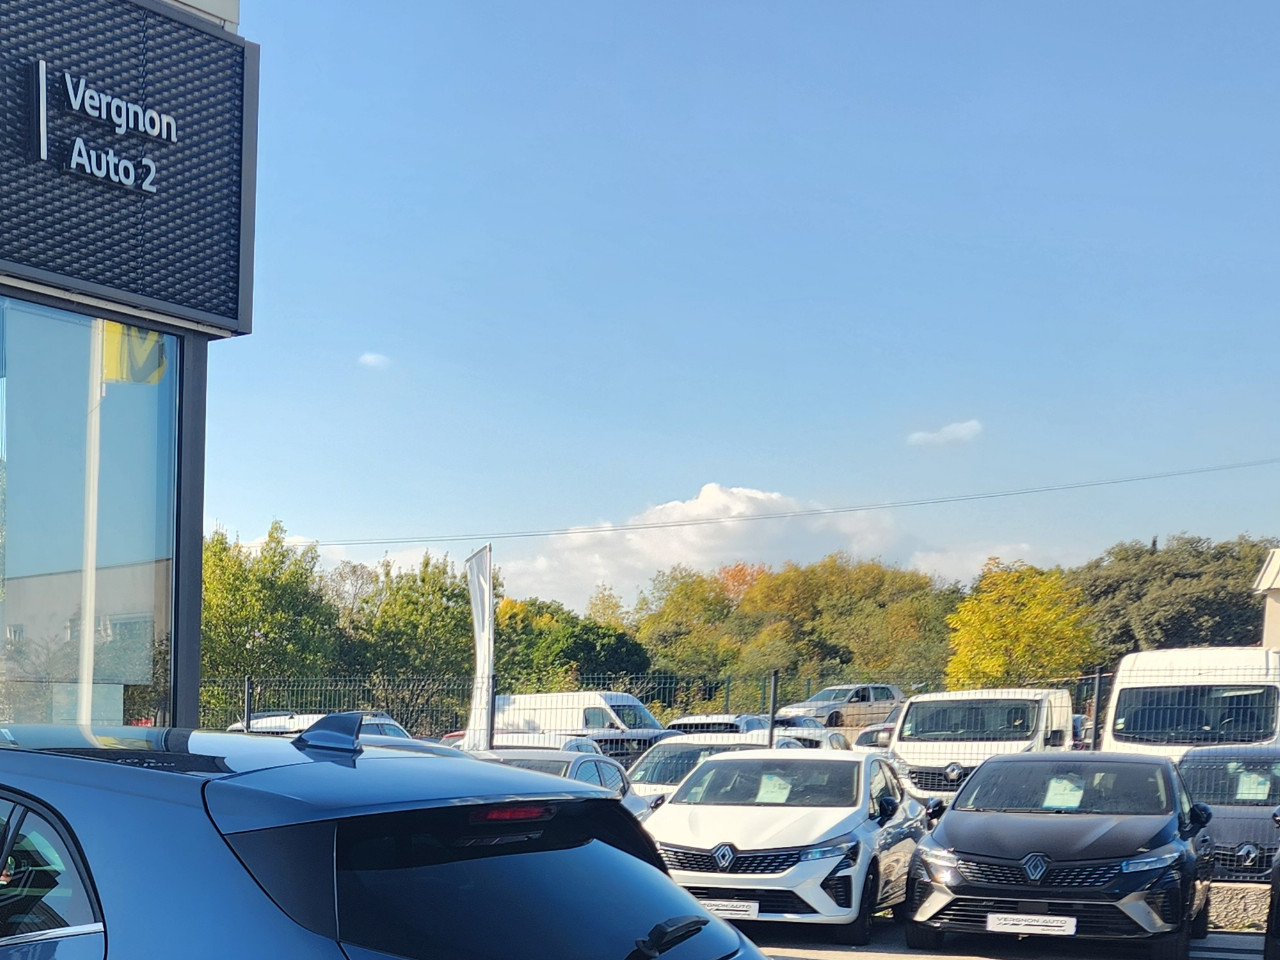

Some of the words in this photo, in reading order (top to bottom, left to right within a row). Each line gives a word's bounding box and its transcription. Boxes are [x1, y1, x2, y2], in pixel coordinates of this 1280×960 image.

[64, 72, 178, 143] Vergnon
[70, 137, 135, 186] Auto
[142, 158, 157, 193] 2
[996, 916, 1040, 924] VERGNON
